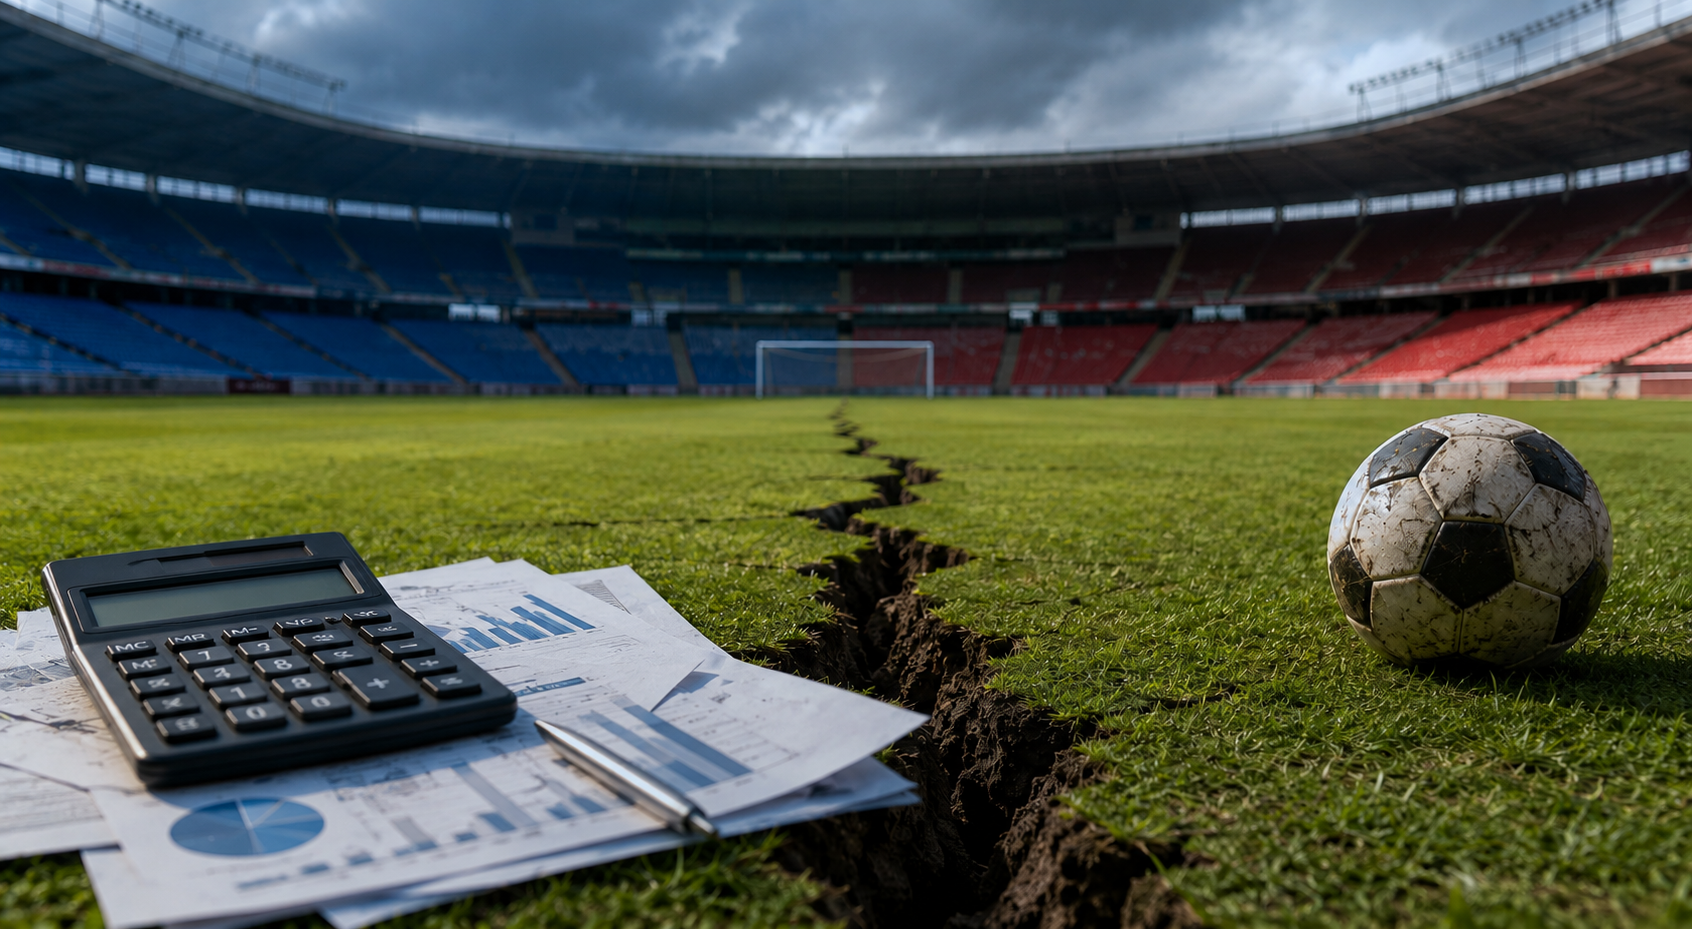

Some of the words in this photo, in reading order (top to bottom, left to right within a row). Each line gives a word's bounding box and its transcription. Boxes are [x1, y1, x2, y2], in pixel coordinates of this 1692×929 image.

[115, 641, 149, 652] MC
[273, 659, 293, 670] 8
[245, 706, 267, 719] 0
